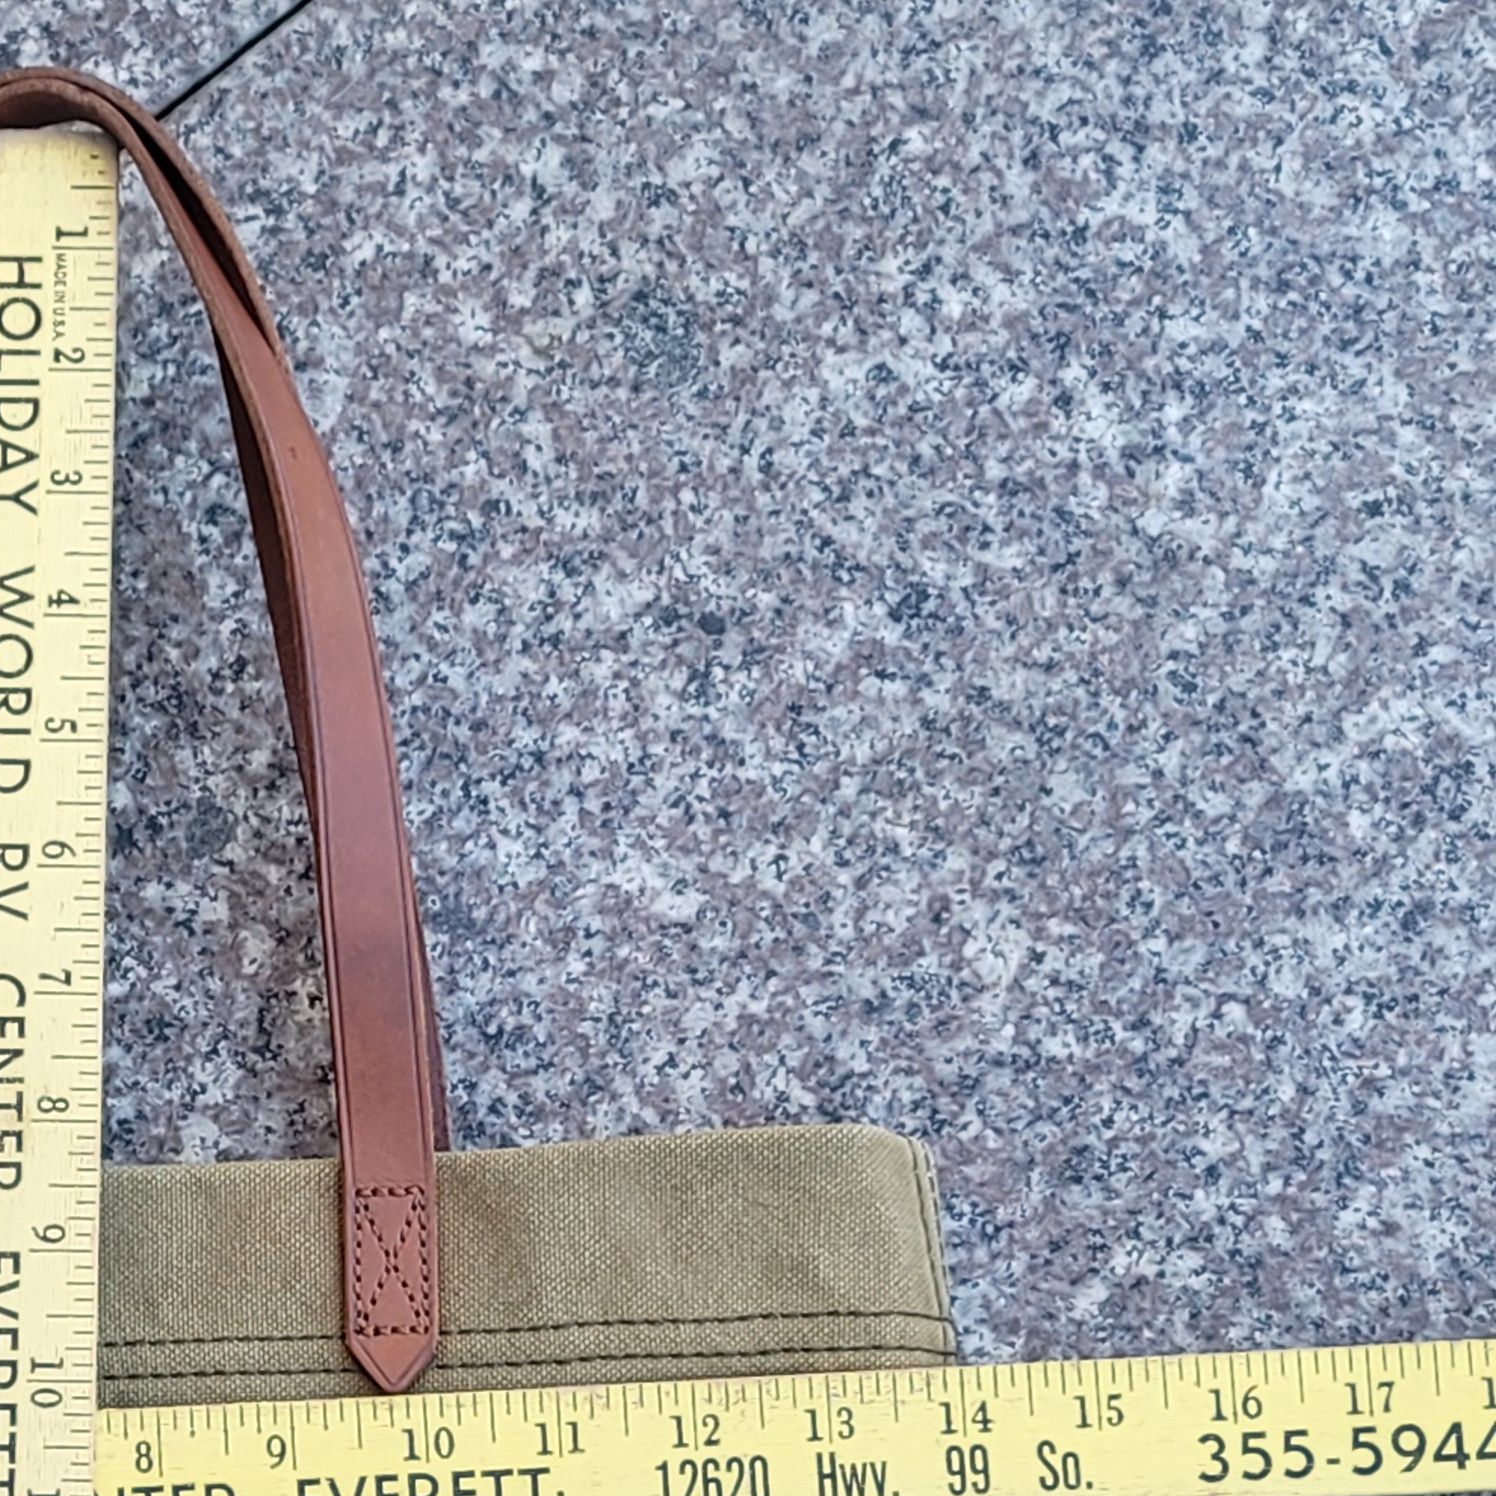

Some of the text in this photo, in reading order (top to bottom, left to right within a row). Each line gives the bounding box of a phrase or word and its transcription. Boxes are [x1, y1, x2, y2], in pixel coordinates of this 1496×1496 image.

[54, 225, 89, 242] 1
[53, 252, 67, 288] MADE
[53, 290, 66, 304] IN
[52, 347, 86, 364] 2
[49, 469, 83, 486] 3
[47, 588, 81, 609] 4
[44, 716, 78, 734] 5
[41, 839, 77, 860] 6
[37, 968, 73, 987] 7
[36, 1095, 70, 1114] 8
[31, 1223, 66, 1244] 9
[134, 1440, 154, 1474] 8
[265, 1433, 287, 1470] 9
[1036, 1439, 1094, 1492] So.
